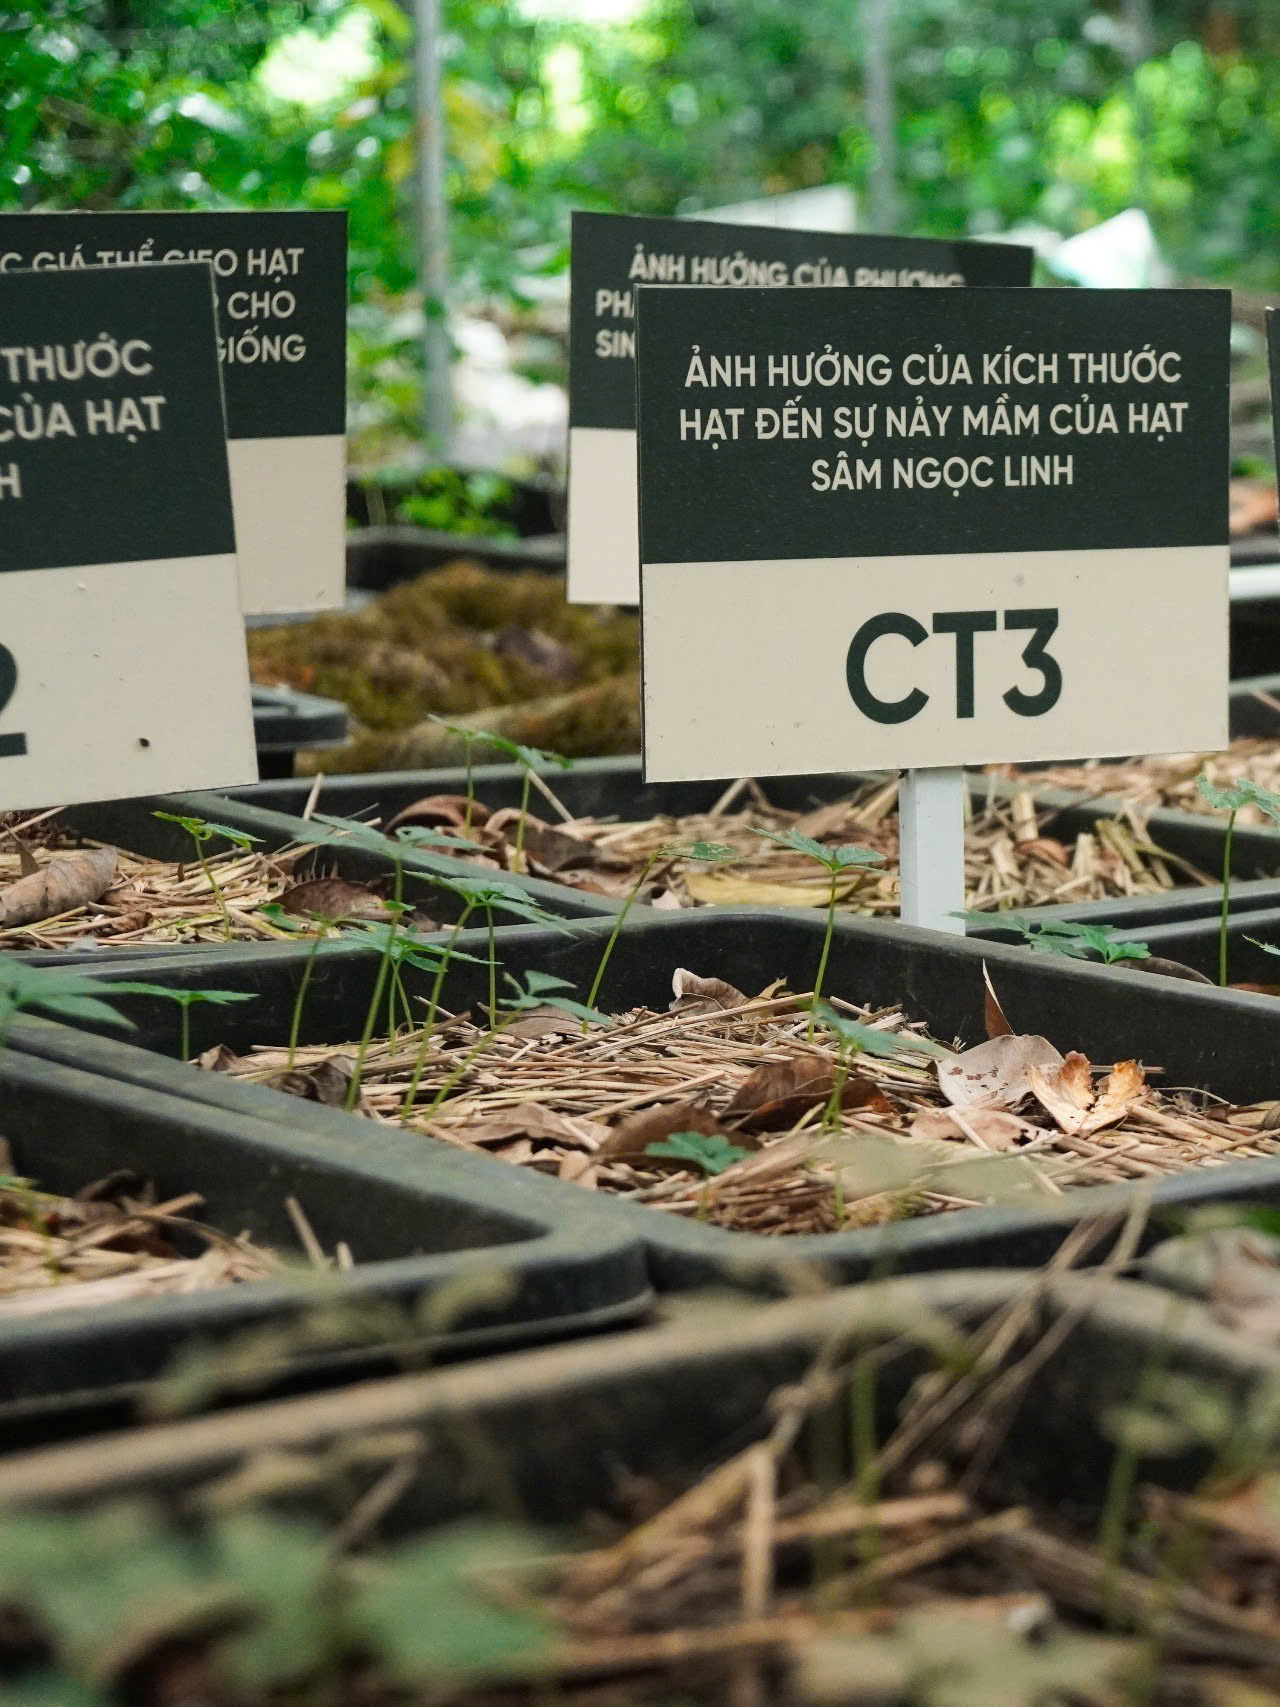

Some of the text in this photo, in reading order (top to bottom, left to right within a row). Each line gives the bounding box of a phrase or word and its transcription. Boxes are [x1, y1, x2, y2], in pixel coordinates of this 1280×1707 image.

[247, 248, 305, 283] HẠT
[628, 243, 686, 281] ẢNH
[227, 290, 296, 319] CHO
[595, 288, 634, 318] PH
[595, 328, 635, 358] SIN
[684, 344, 1182, 388] ẢNH HƯỞNG CỦA KÍCH THƯỚC
[86, 396, 166, 443] HẠT
[680, 393, 1189, 450] HẠT ĐẾN SỰ NẢY MẦM CỦA HẠT
[811, 450, 1073, 498] SÂM NGỌC LINH
[846, 608, 1063, 725] CT3
